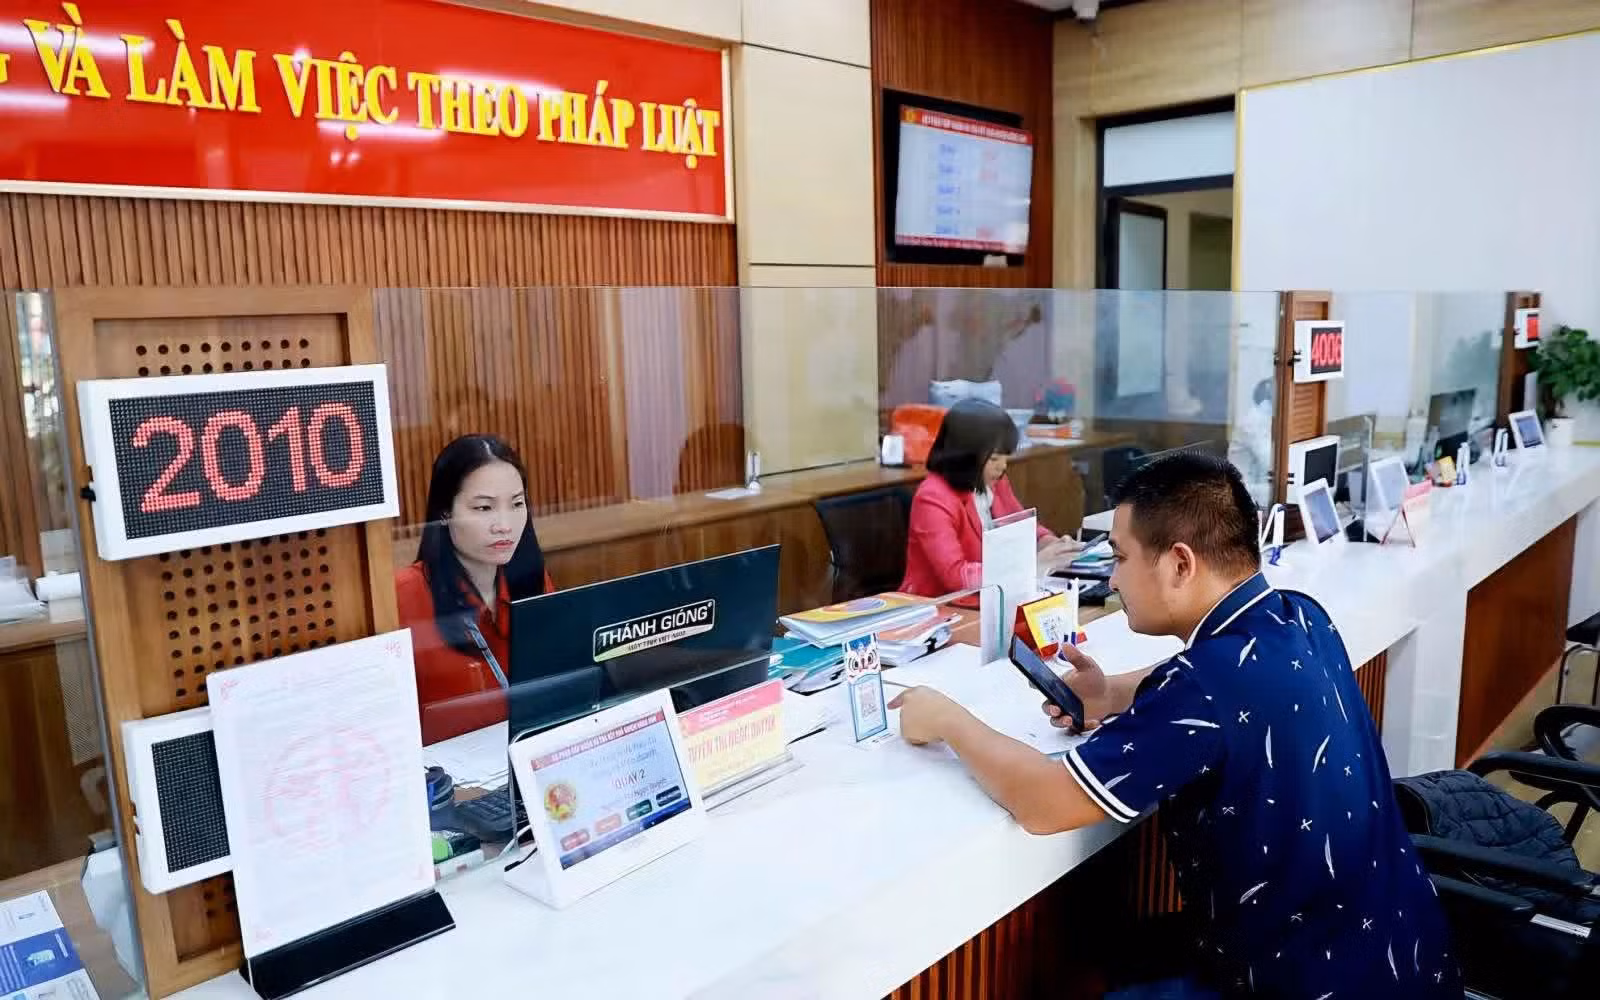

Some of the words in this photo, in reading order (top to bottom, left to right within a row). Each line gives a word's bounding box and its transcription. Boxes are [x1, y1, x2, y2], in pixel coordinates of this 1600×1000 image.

[24, 2, 111, 99] VÀ
[120, 19, 262, 113] LÀM
[273, 51, 399, 141] VIỆC
[407, 72, 528, 138] THEO
[536, 80, 635, 149] PHÁP
[639, 98, 720, 169] LUẬT
[133, 401, 364, 513] 2010
[599, 620, 657, 647] THÁNH
[660, 605, 708, 630] GIÓNG
